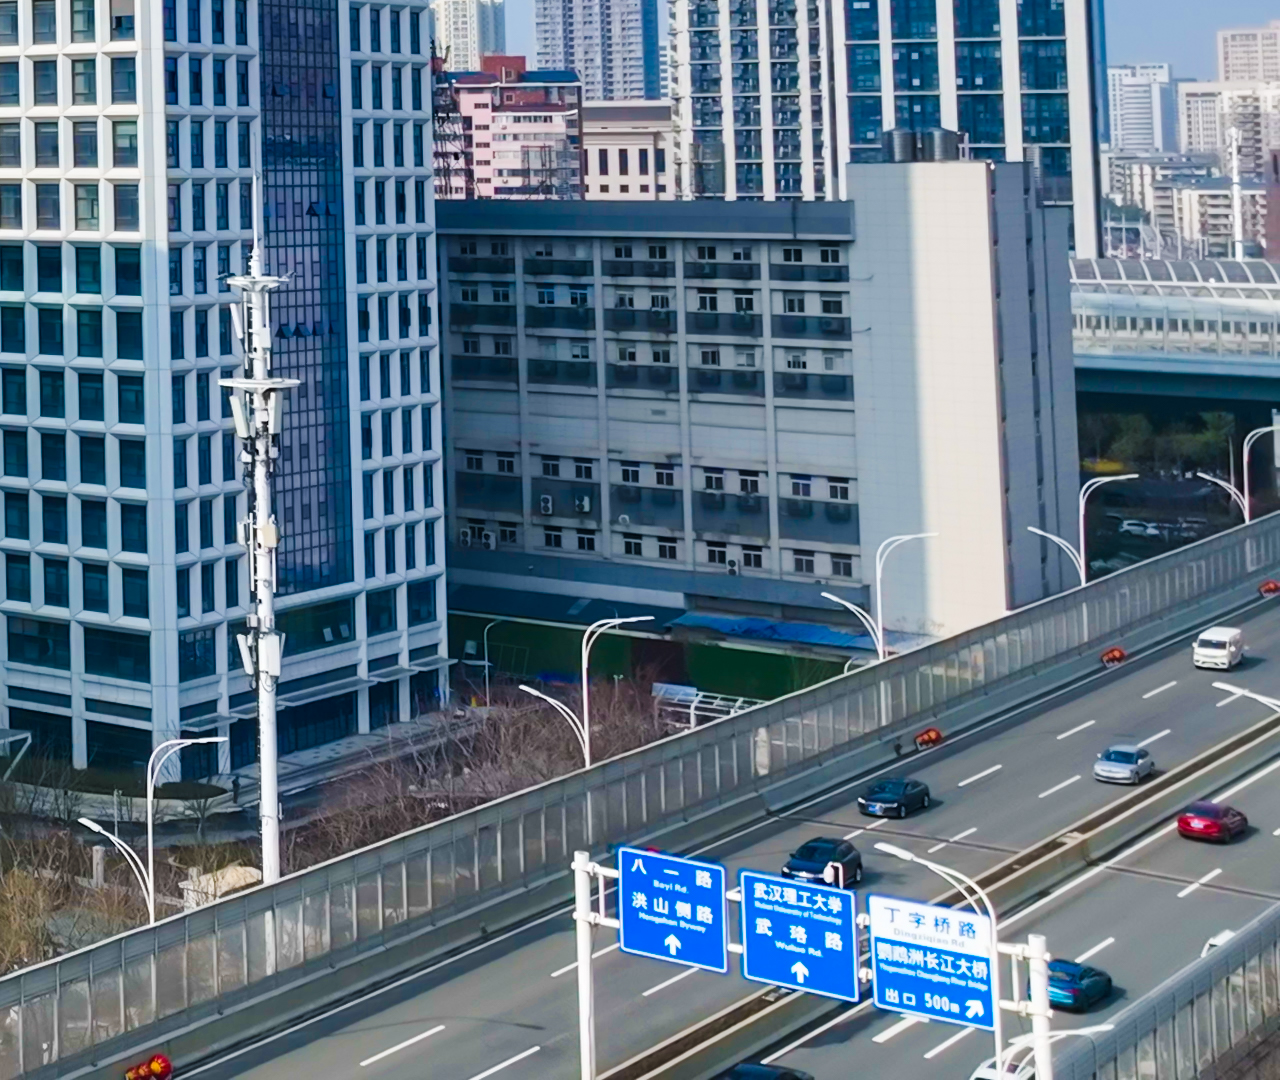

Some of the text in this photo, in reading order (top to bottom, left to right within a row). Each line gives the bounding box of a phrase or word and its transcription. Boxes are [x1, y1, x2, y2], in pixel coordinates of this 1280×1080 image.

[631, 858, 713, 888] 八一路
[653, 879, 673, 891] Bayi
[631, 891, 714, 925] 洪山侧路
[753, 882, 842, 914] 武汉理工大学
[755, 917, 843, 951] 武珞路
[884, 906, 976, 940] 丁字桥路
[876, 941, 989, 980] 鹦鹉洲长江大桥
[885, 987, 960, 1013] 出口 500m
